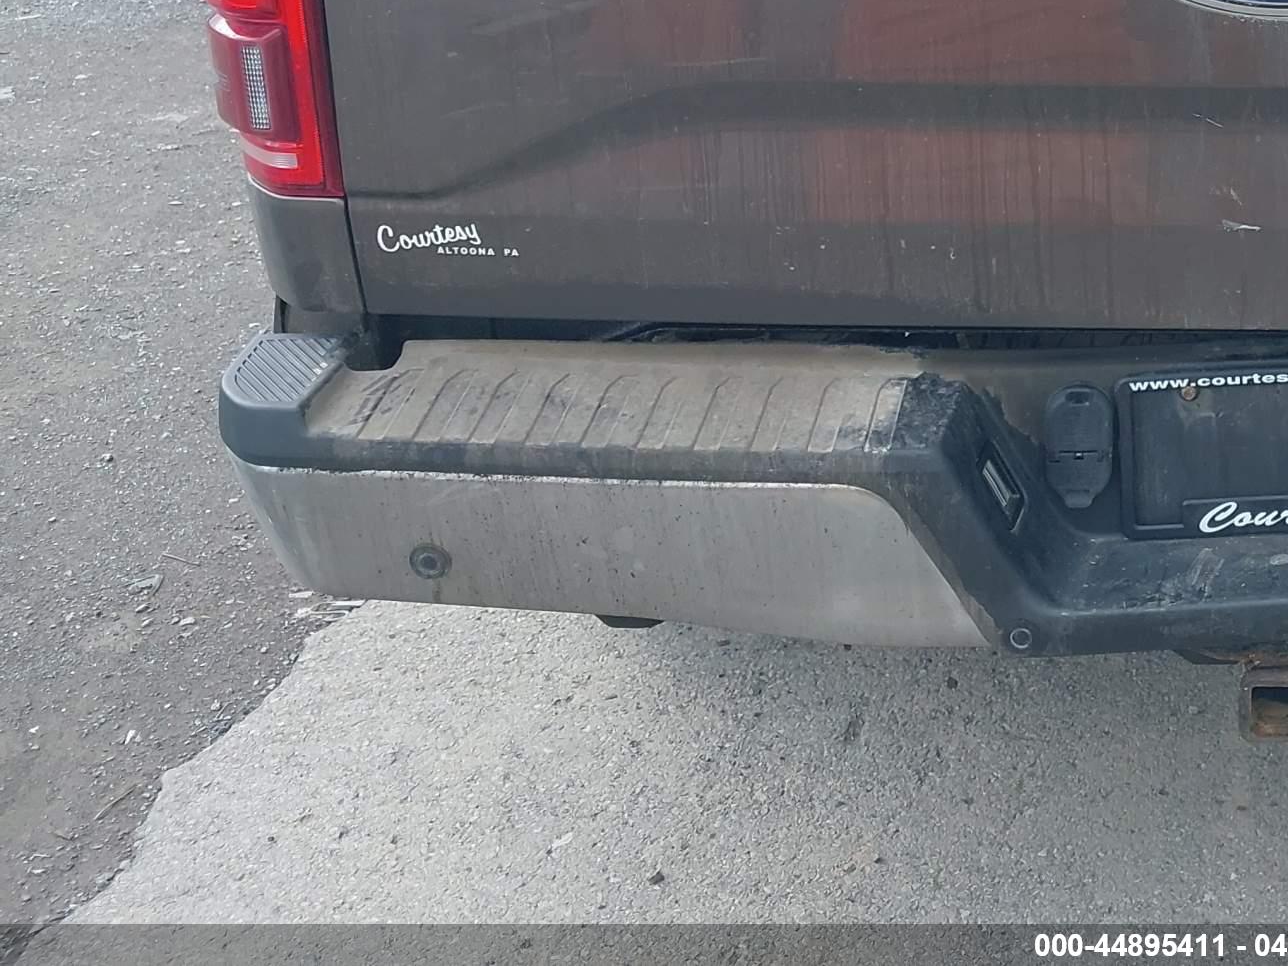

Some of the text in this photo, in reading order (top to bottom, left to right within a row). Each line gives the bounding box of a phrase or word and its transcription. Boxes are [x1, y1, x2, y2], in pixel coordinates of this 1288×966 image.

[376, 223, 482, 253] Courtesy
[437, 246, 520, 257] ALTOONA PA
